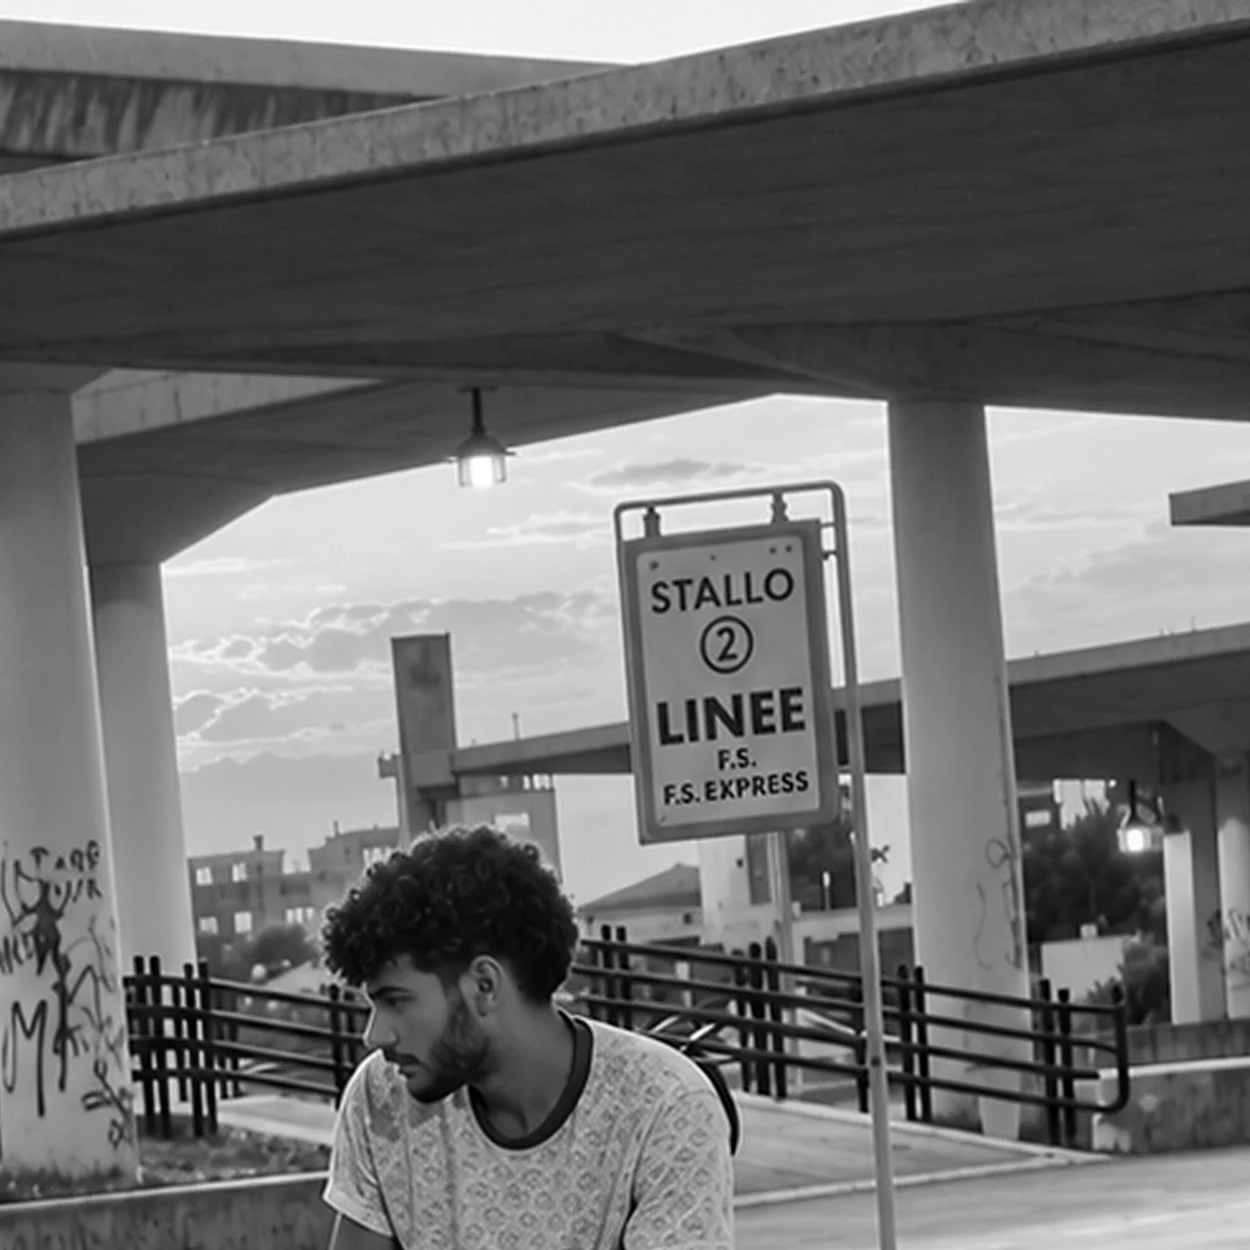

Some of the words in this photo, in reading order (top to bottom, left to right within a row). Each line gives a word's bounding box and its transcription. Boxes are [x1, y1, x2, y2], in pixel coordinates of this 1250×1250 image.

[650, 567, 795, 615] STALLO
[656, 686, 806, 747] LINEE
[717, 747, 757, 771] F.S.
[704, 770, 809, 802] EXPRESS
